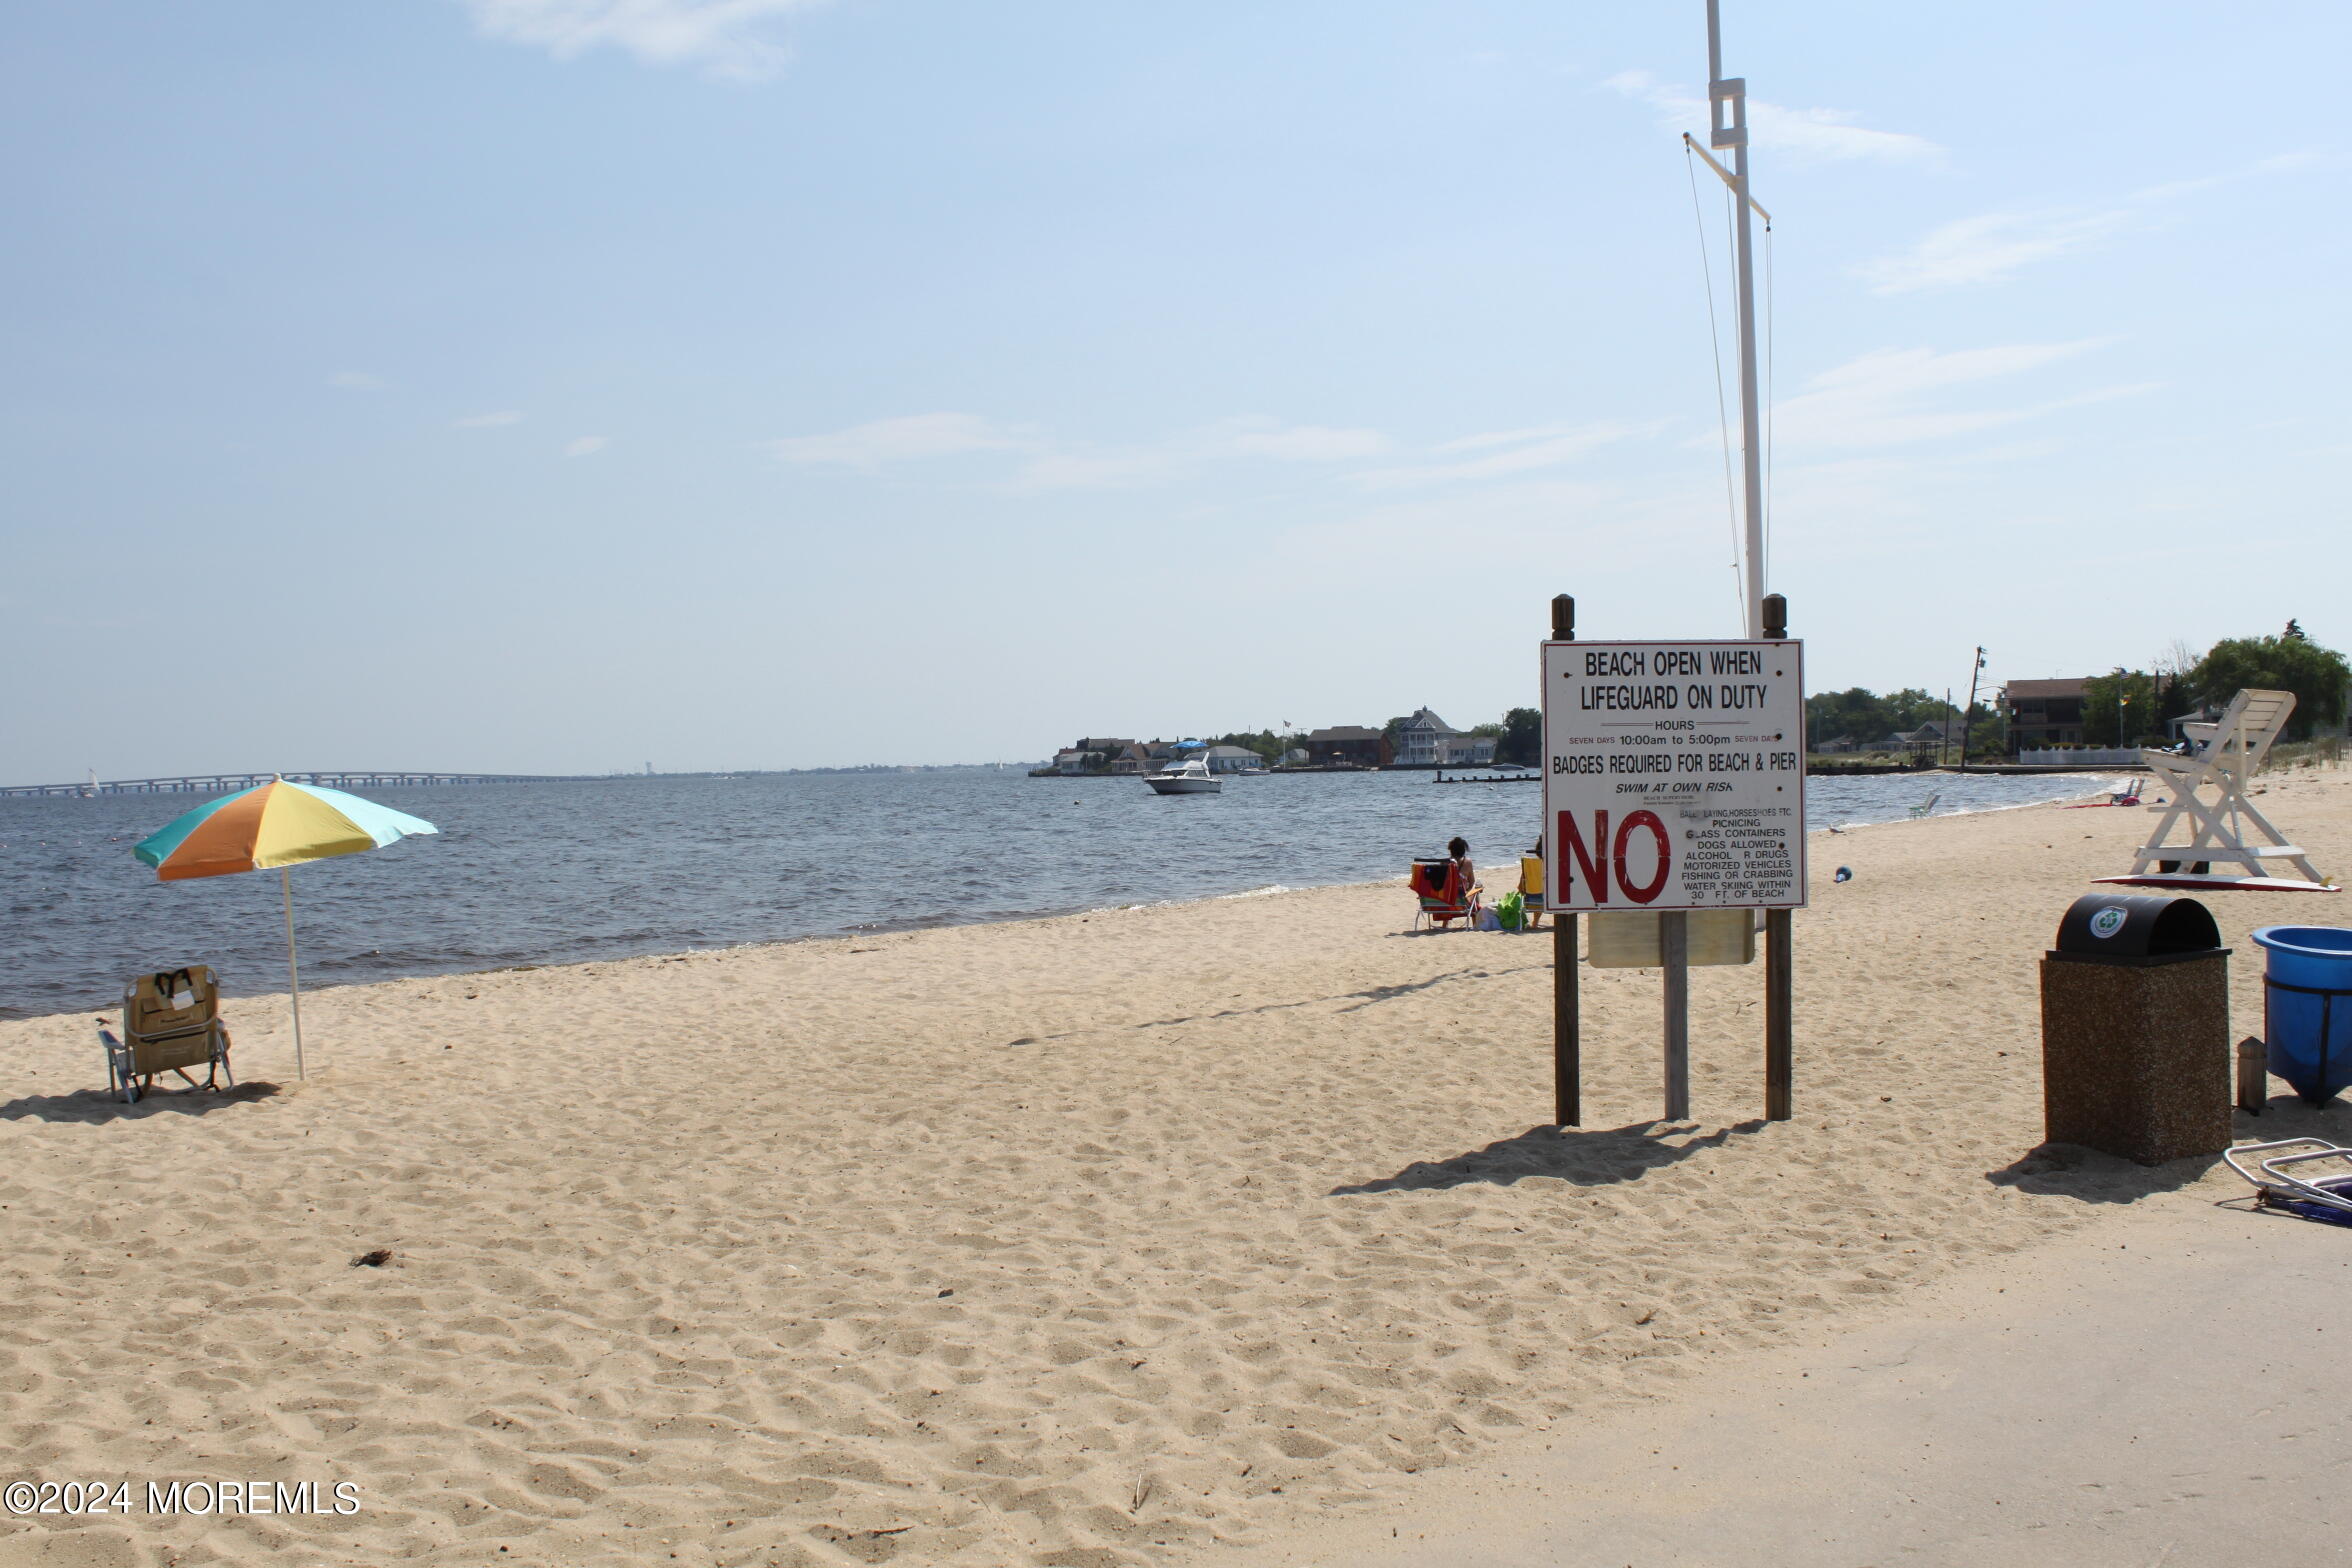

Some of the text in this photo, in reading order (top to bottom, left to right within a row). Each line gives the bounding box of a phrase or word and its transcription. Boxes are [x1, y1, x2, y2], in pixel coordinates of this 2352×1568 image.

[1585, 650, 1761, 677] BEACH OPEN WHEN
[1581, 684, 1767, 710] LIFEGUARD ON DUTY
[1655, 721, 1695, 731] HOURS
[1569, 737, 1594, 745] SEVEN
[1619, 736, 1667, 746] 10:00am
[1672, 735, 1684, 745] to
[1688, 735, 1731, 747] 5:00pm
[1734, 735, 1759, 743] SEVEN
[1553, 752, 1796, 775] BADGES REQUIRED FOR BEACH & PIER
[1615, 782, 1733, 794] SWIM AT OWN RISK
[1712, 819, 1760, 827] PICNICING
[1686, 829, 1786, 839] GASS CONTAINERS
[1697, 840, 1776, 850] DOGS ALLOWED
[1558, 809, 1671, 904] NO
[1686, 852, 1732, 860] ALCOHOL
[1755, 850, 1789, 859] DRUGS
[1683, 860, 1791, 870] MOTORIZED VEHICLES
[1681, 870, 1793, 880] FISHING OR CRABBING
[1684, 881, 1791, 891] WATER SKIING WITHIN
[1691, 889, 1785, 900] 30 FT. OF BEACH
